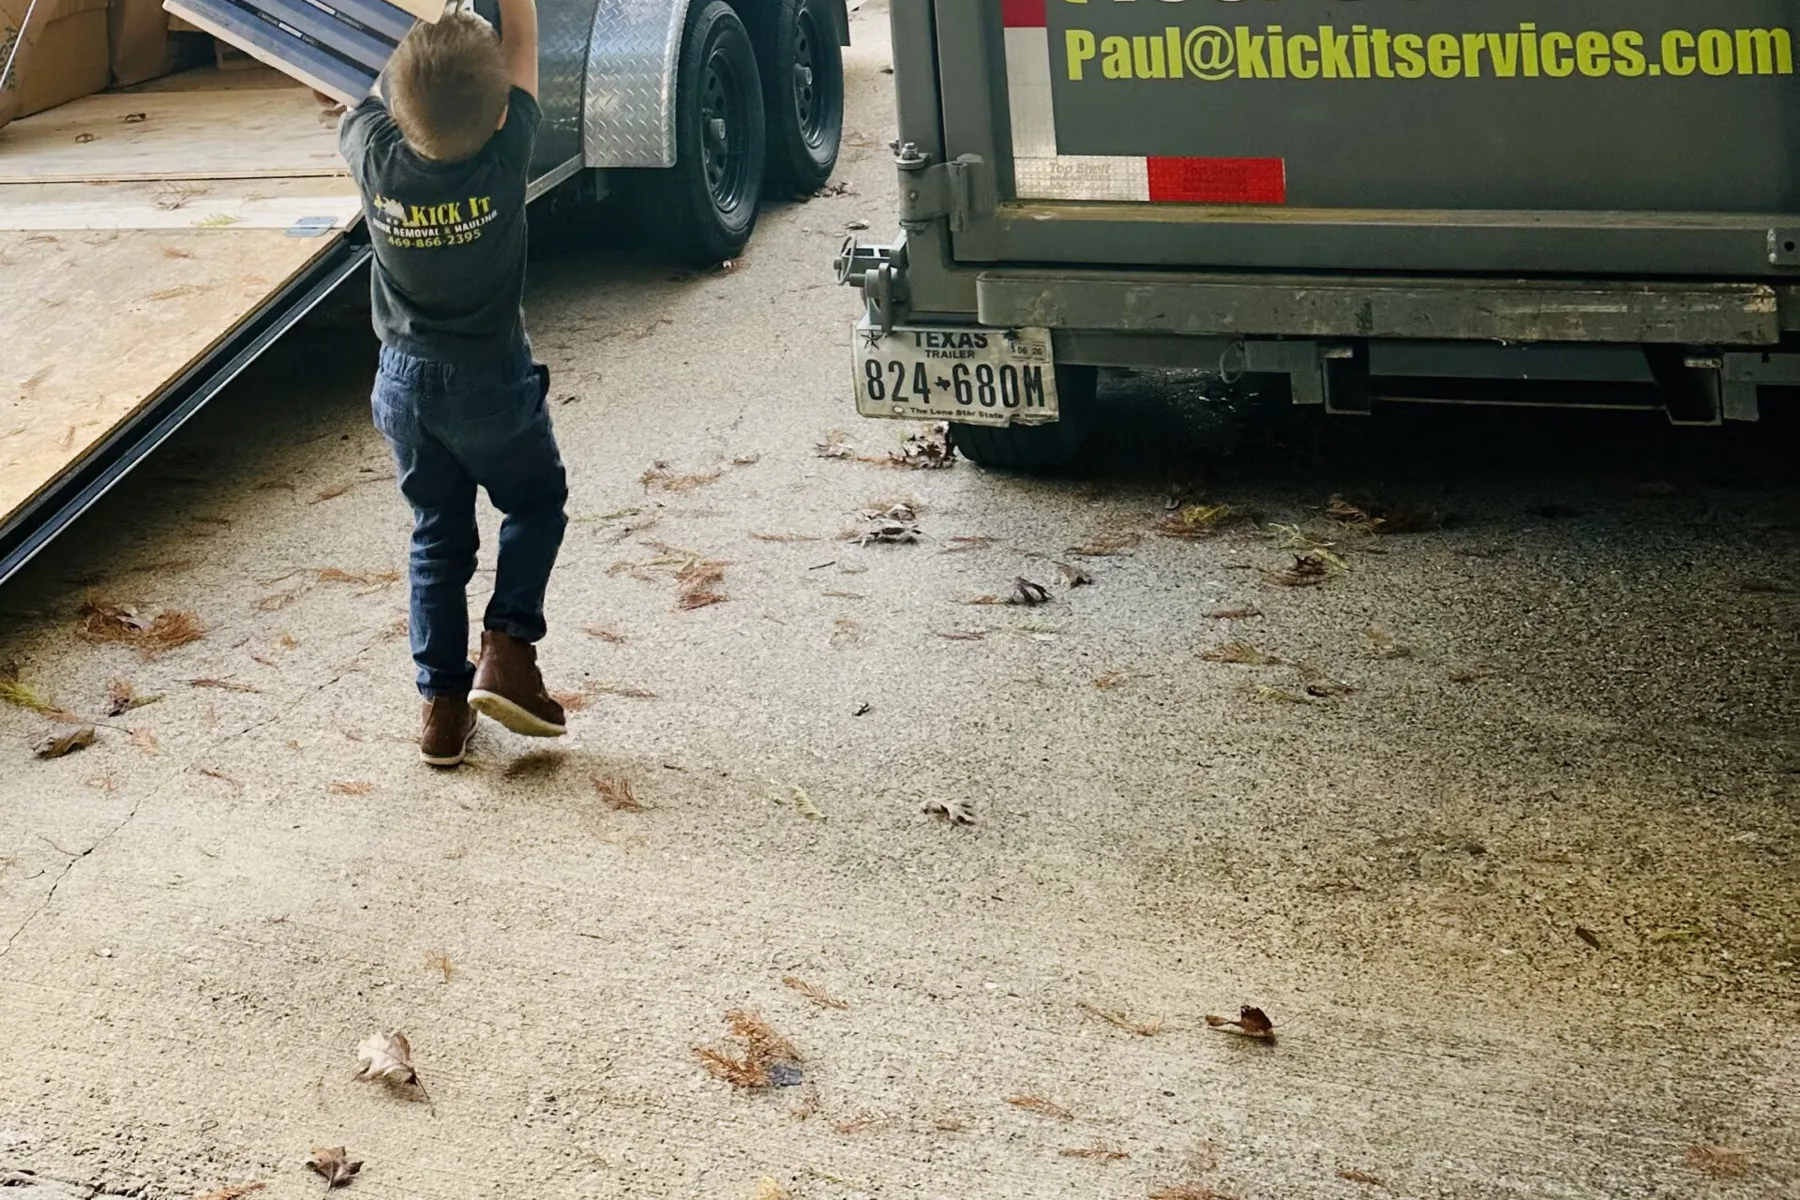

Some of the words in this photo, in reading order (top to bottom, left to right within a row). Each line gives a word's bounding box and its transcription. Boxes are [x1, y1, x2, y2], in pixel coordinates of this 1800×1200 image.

[1065, 23, 1794, 81] Paul@kickitservices.com
[409, 202, 462, 227] KICK
[468, 196, 491, 218] IT
[393, 227, 440, 238] REMOVAL
[454, 209, 499, 233] HAULING
[387, 228, 482, 249] 469-866-2395
[912, 332, 988, 349] TEXAS
[925, 350, 975, 359] TRAILER
[910, 407, 930, 415] The
[930, 408, 953, 416] Lone
[956, 409, 976, 417] Star
[979, 411, 1004, 420] State
